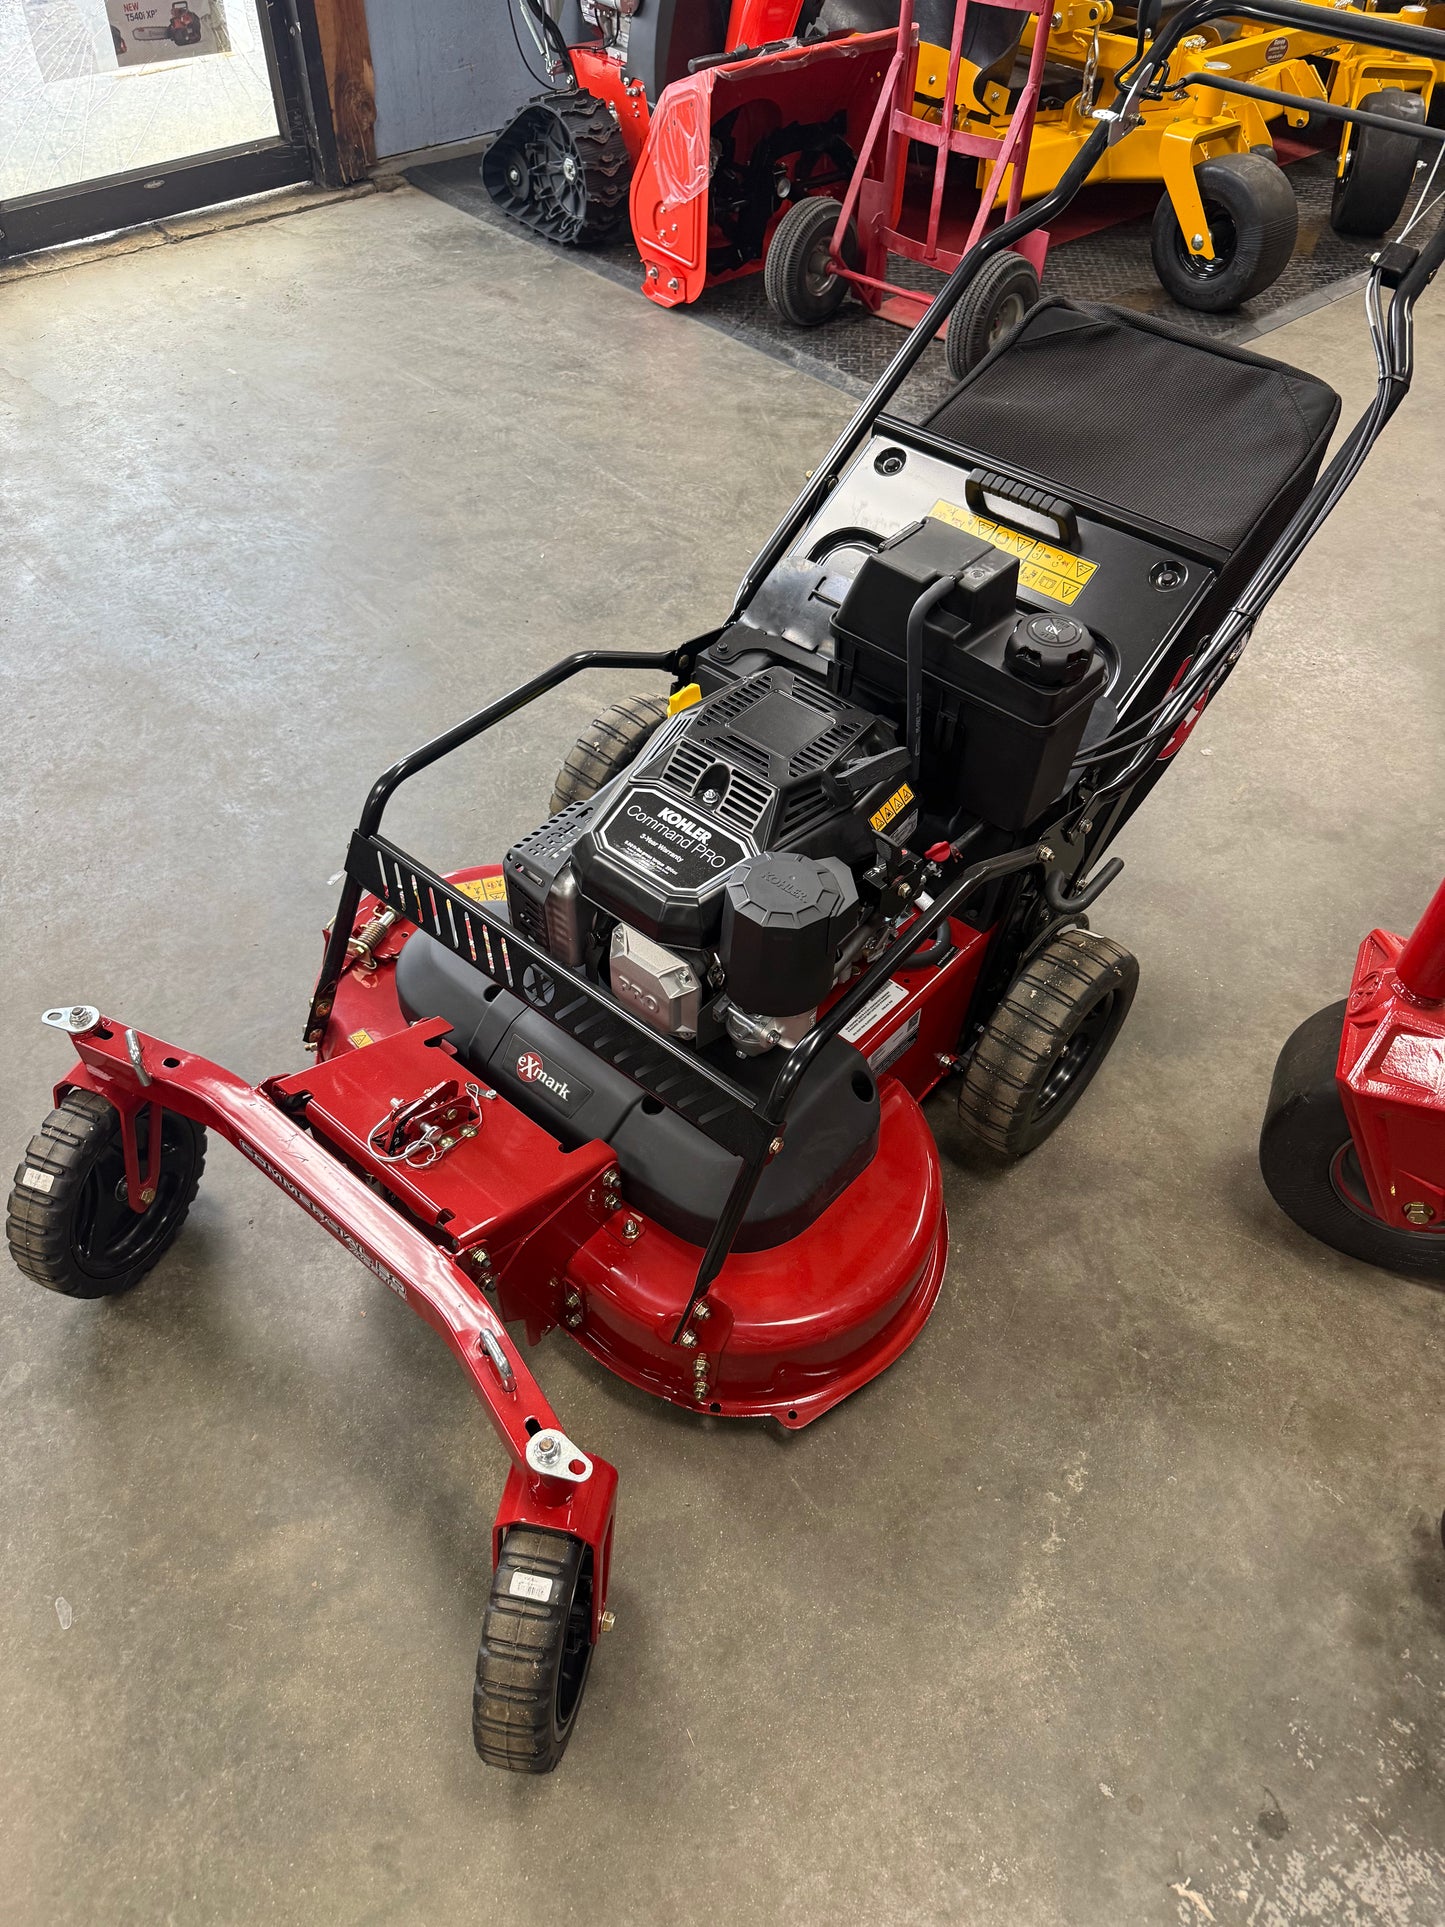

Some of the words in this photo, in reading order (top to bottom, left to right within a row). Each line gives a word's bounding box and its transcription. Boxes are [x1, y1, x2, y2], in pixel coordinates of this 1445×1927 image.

[123, 2, 139, 12] NEW
[125, 10, 145, 22] T540i
[627, 805, 695, 849] Command
[691, 843, 726, 868] PRO
[640, 833, 659, 847] 3-Year
[657, 844, 684, 863] Warranty
[618, 974, 660, 1014] PRO
[239, 1138, 373, 1267] COMMERCIAL
